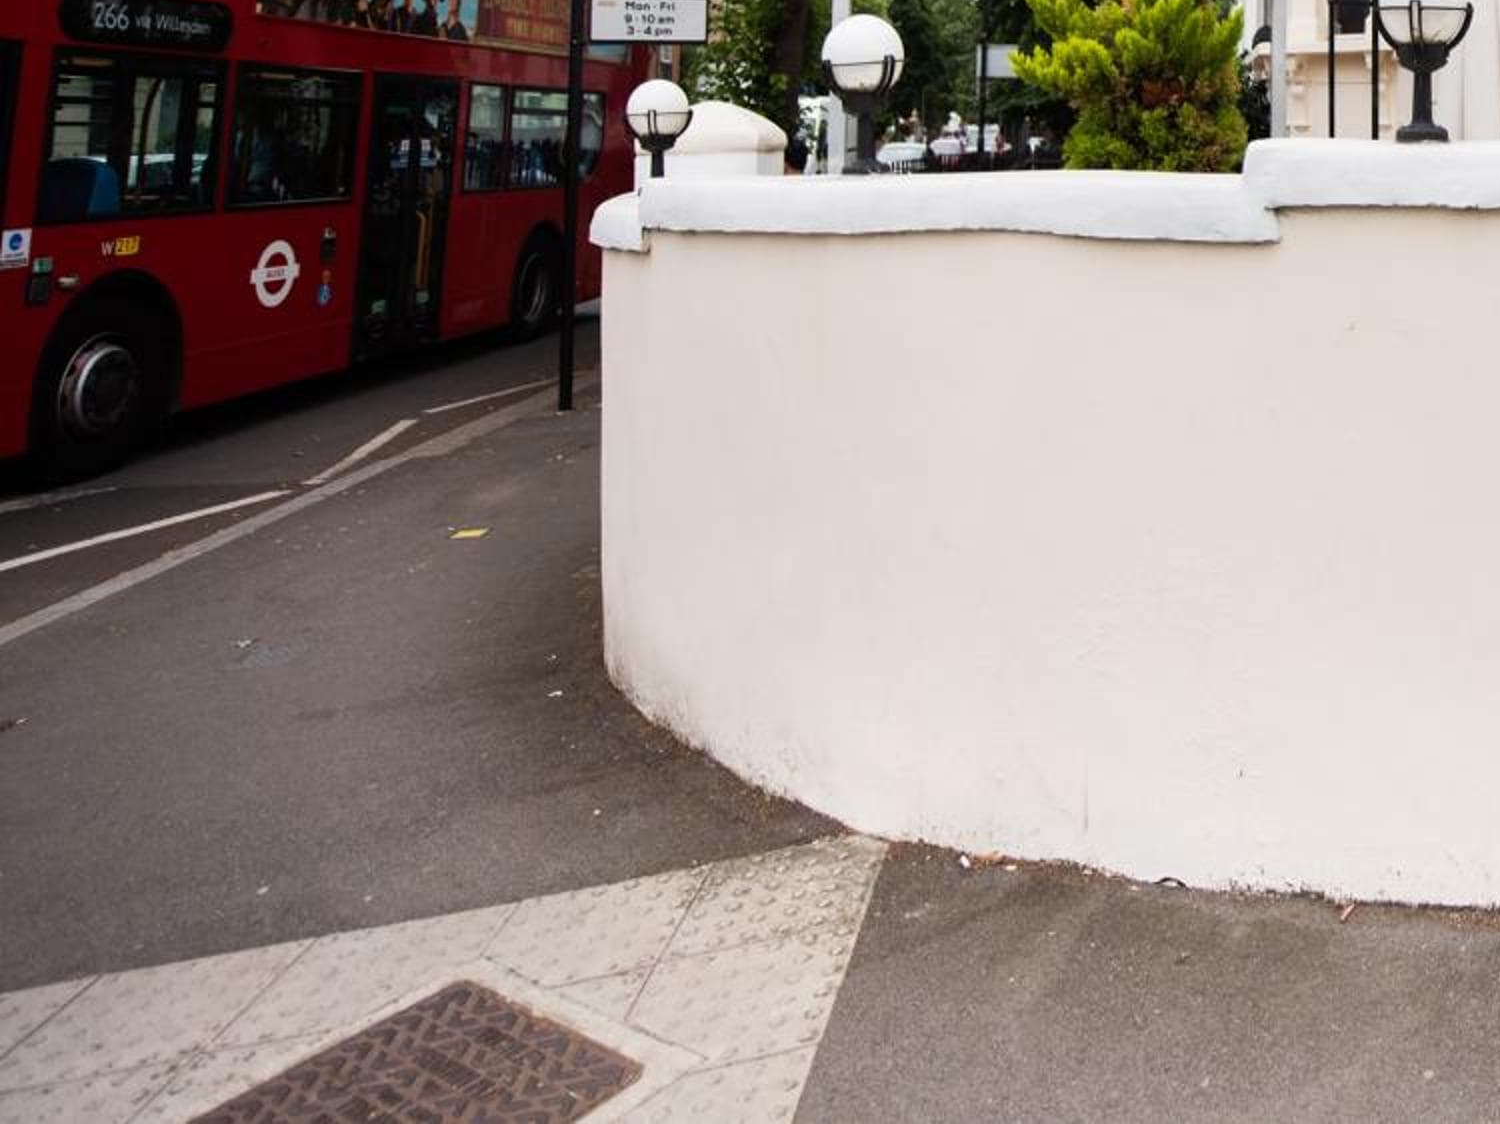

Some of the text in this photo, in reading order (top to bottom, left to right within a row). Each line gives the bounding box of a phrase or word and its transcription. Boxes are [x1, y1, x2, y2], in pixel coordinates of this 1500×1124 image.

[624, 1, 651, 11] Mon
[660, 2, 676, 12] Fri
[94, 2, 129, 30] 266
[641, 14, 656, 24] 10
[658, 17, 675, 25] am
[643, 26, 652, 35] 4
[655, 28, 673, 37] pm
